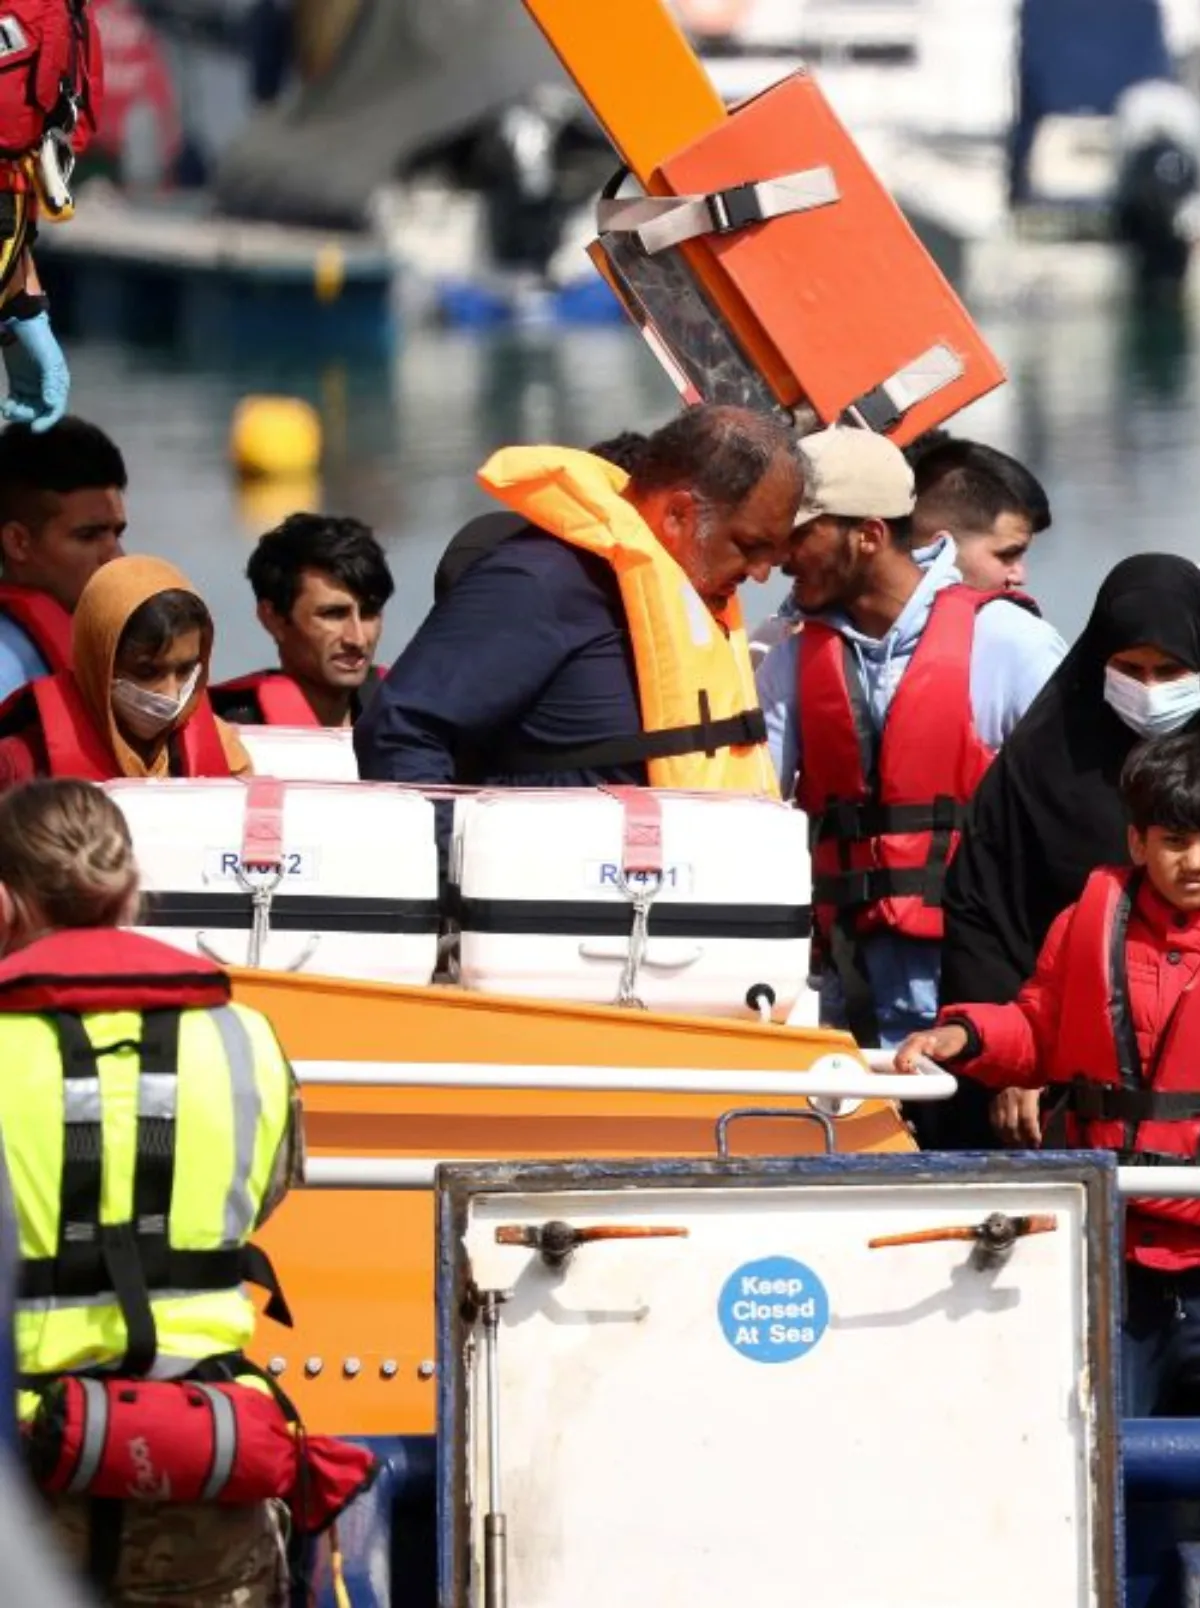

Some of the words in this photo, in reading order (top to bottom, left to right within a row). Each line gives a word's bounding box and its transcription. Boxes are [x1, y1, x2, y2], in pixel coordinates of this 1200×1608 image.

[741, 1276, 803, 1298] Keep
[732, 1297, 815, 1321] Closed
[735, 1326, 760, 1344] At
[769, 1323, 815, 1344] Sea
